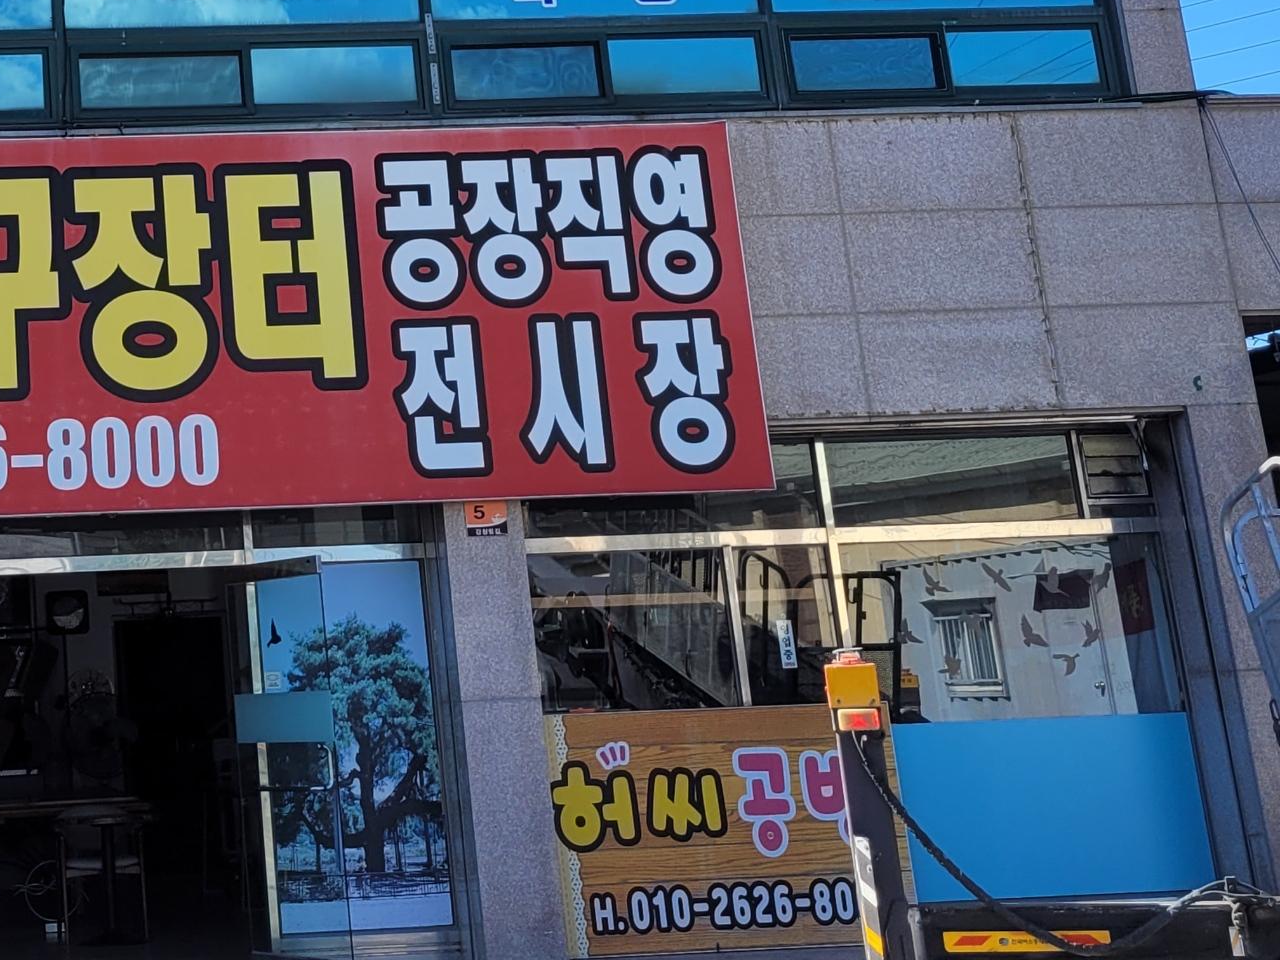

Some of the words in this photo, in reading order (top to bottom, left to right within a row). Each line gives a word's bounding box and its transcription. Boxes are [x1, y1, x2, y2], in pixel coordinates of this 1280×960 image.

[375, 145, 721, 310] 공장직영
[391, 309, 736, 480] 전시장
[473, 504, 486, 520] 5
